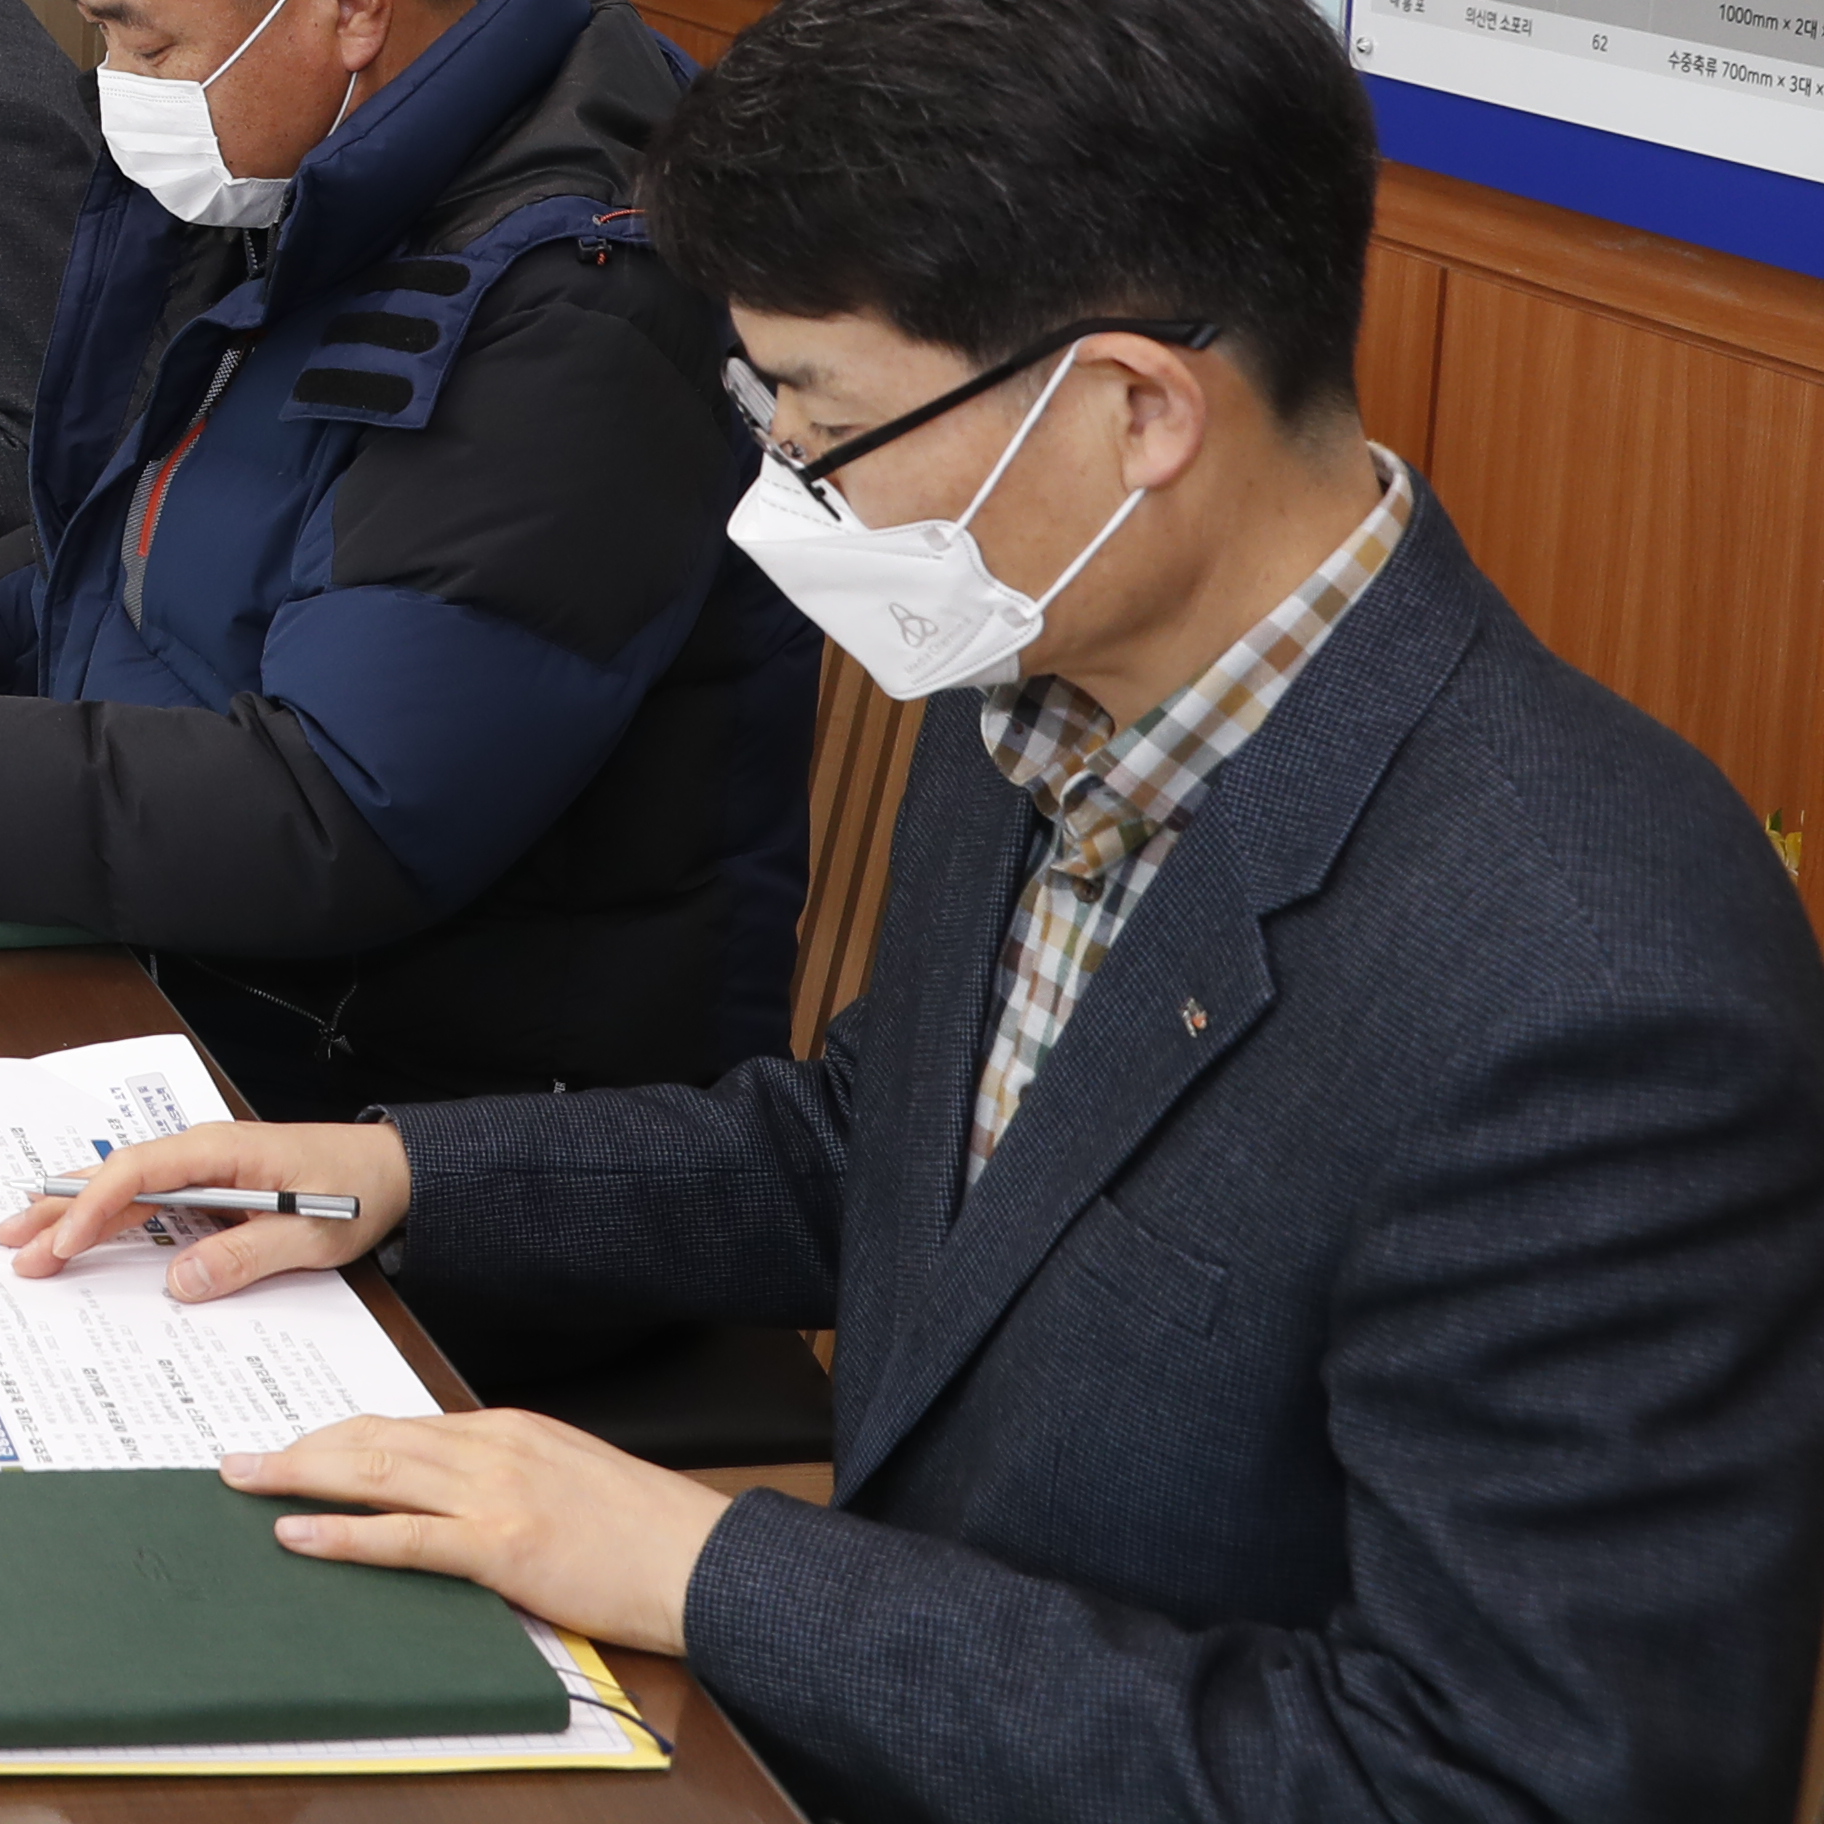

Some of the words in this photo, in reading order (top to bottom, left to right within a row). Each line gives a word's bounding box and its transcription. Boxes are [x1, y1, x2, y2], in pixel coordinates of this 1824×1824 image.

[1464, 5, 1498, 31] 의신면
[1591, 33, 1609, 53] 62
[1667, 49, 1718, 79] 수중축류
[1721, 59, 1774, 88] 700mm
[1789, 74, 1813, 98] 3대
[1718, 3, 1780, 32] 1000mm
[1794, 16, 1818, 40] 2대
